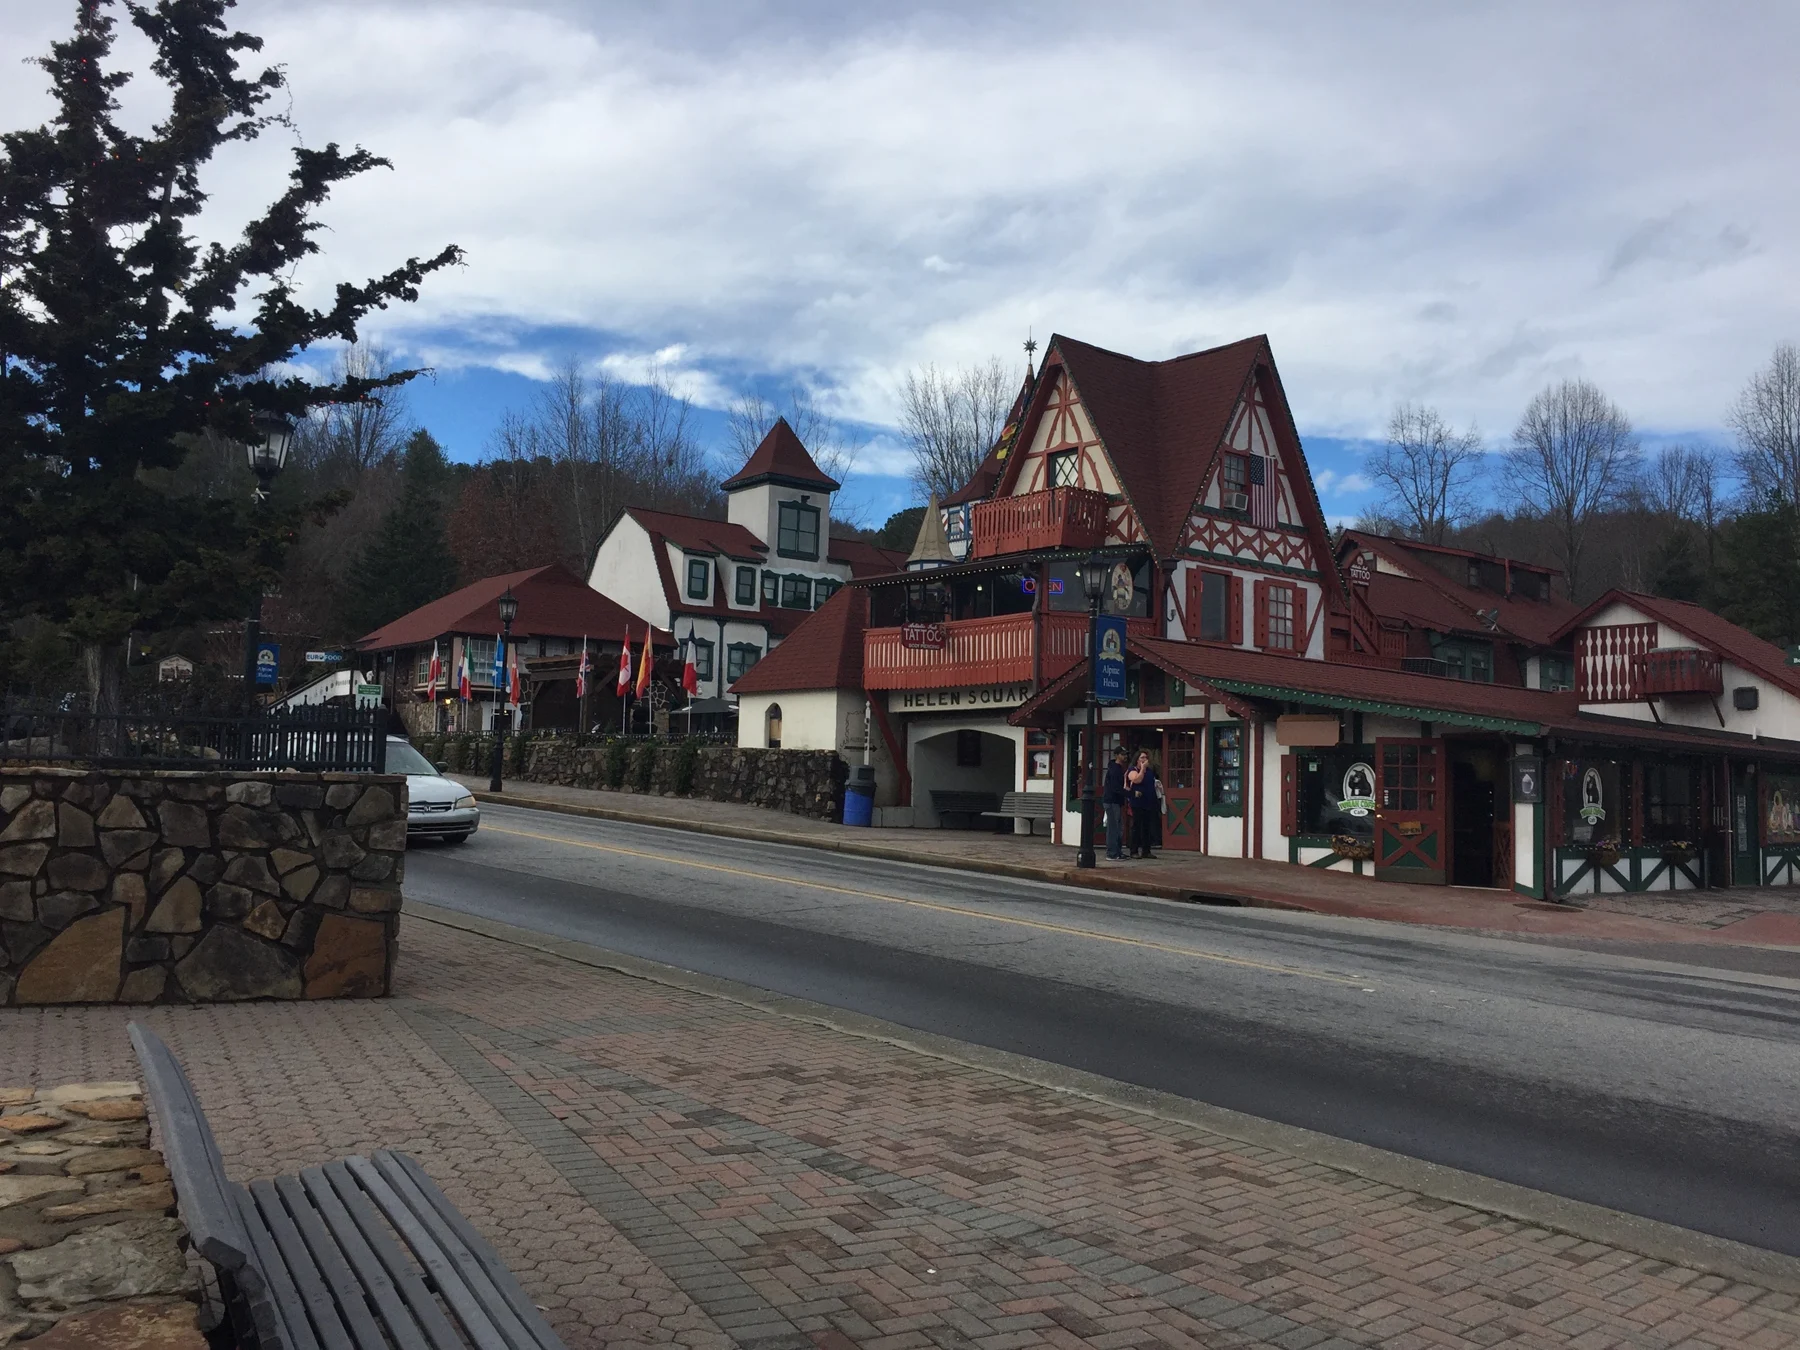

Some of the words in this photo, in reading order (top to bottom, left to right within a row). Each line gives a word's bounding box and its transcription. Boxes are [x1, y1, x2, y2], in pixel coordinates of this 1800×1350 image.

[1350, 568, 1370, 580] TATTOO
[1025, 581, 1062, 592] ON
[903, 628, 942, 644] TATTOO
[1102, 664, 1120, 677] Alpine
[1103, 678, 1119, 688] Helen
[903, 691, 960, 708] HELEN
[968, 686, 1030, 704] SQUAR
